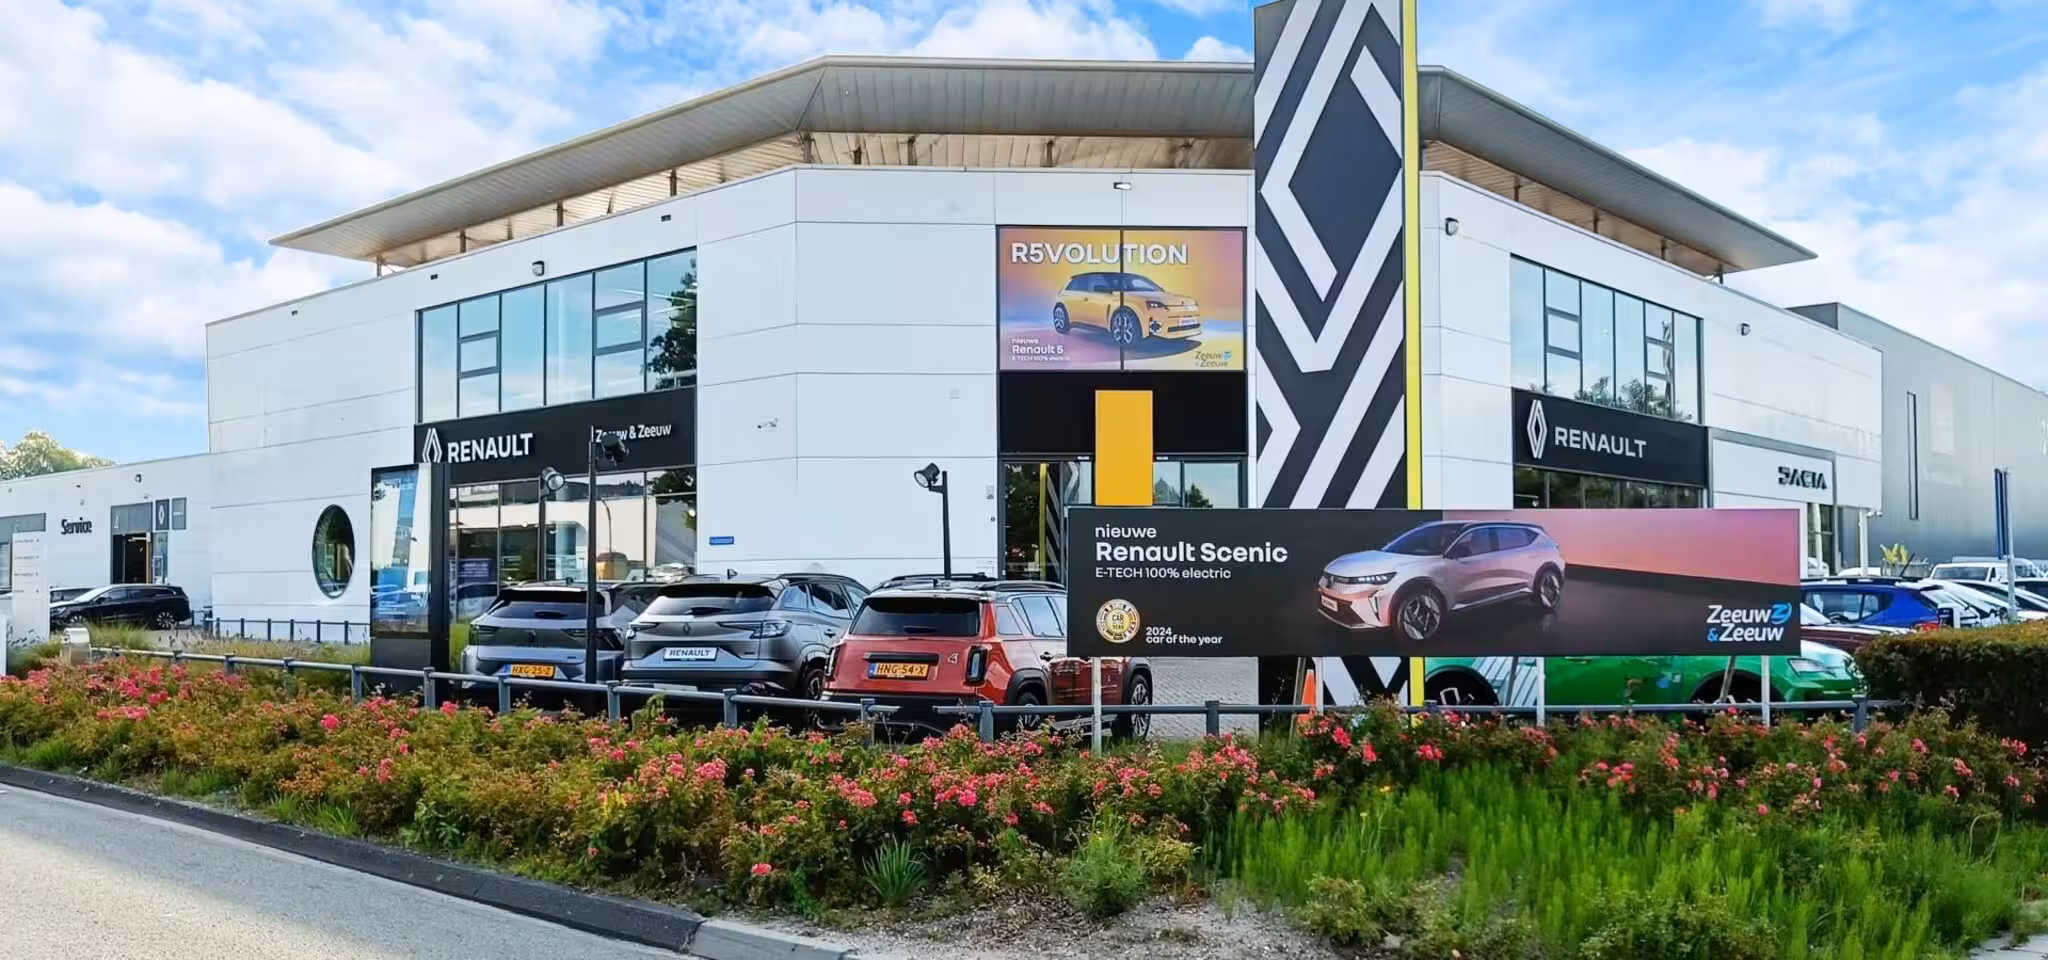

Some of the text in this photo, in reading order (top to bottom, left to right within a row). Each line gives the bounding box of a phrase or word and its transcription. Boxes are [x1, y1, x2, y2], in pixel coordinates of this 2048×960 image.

[1011, 243, 1187, 264] R5VOLUTION
[1012, 344, 1064, 354] Renault 5
[1194, 351, 1222, 360] Zeeuw
[629, 425, 637, 440] &
[637, 424, 672, 438] Zeeuw
[447, 432, 533, 464] RENAULT
[1555, 426, 1647, 458] RENAULT
[1778, 466, 1828, 490] DACIA
[61, 517, 92, 535] Service
[1095, 524, 1157, 538] nieuwe
[1096, 541, 1288, 562] Renault Scenic
[1095, 567, 1232, 579] E-TECH 100% electric
[1706, 604, 1772, 624] Zeeuw
[1146, 627, 1172, 636] 2024
[1707, 623, 1784, 642] & Zeeuw
[1146, 635, 1223, 646] car of the year
[669, 649, 711, 657] RENAULT
[877, 664, 926, 675] HNG-54-X
